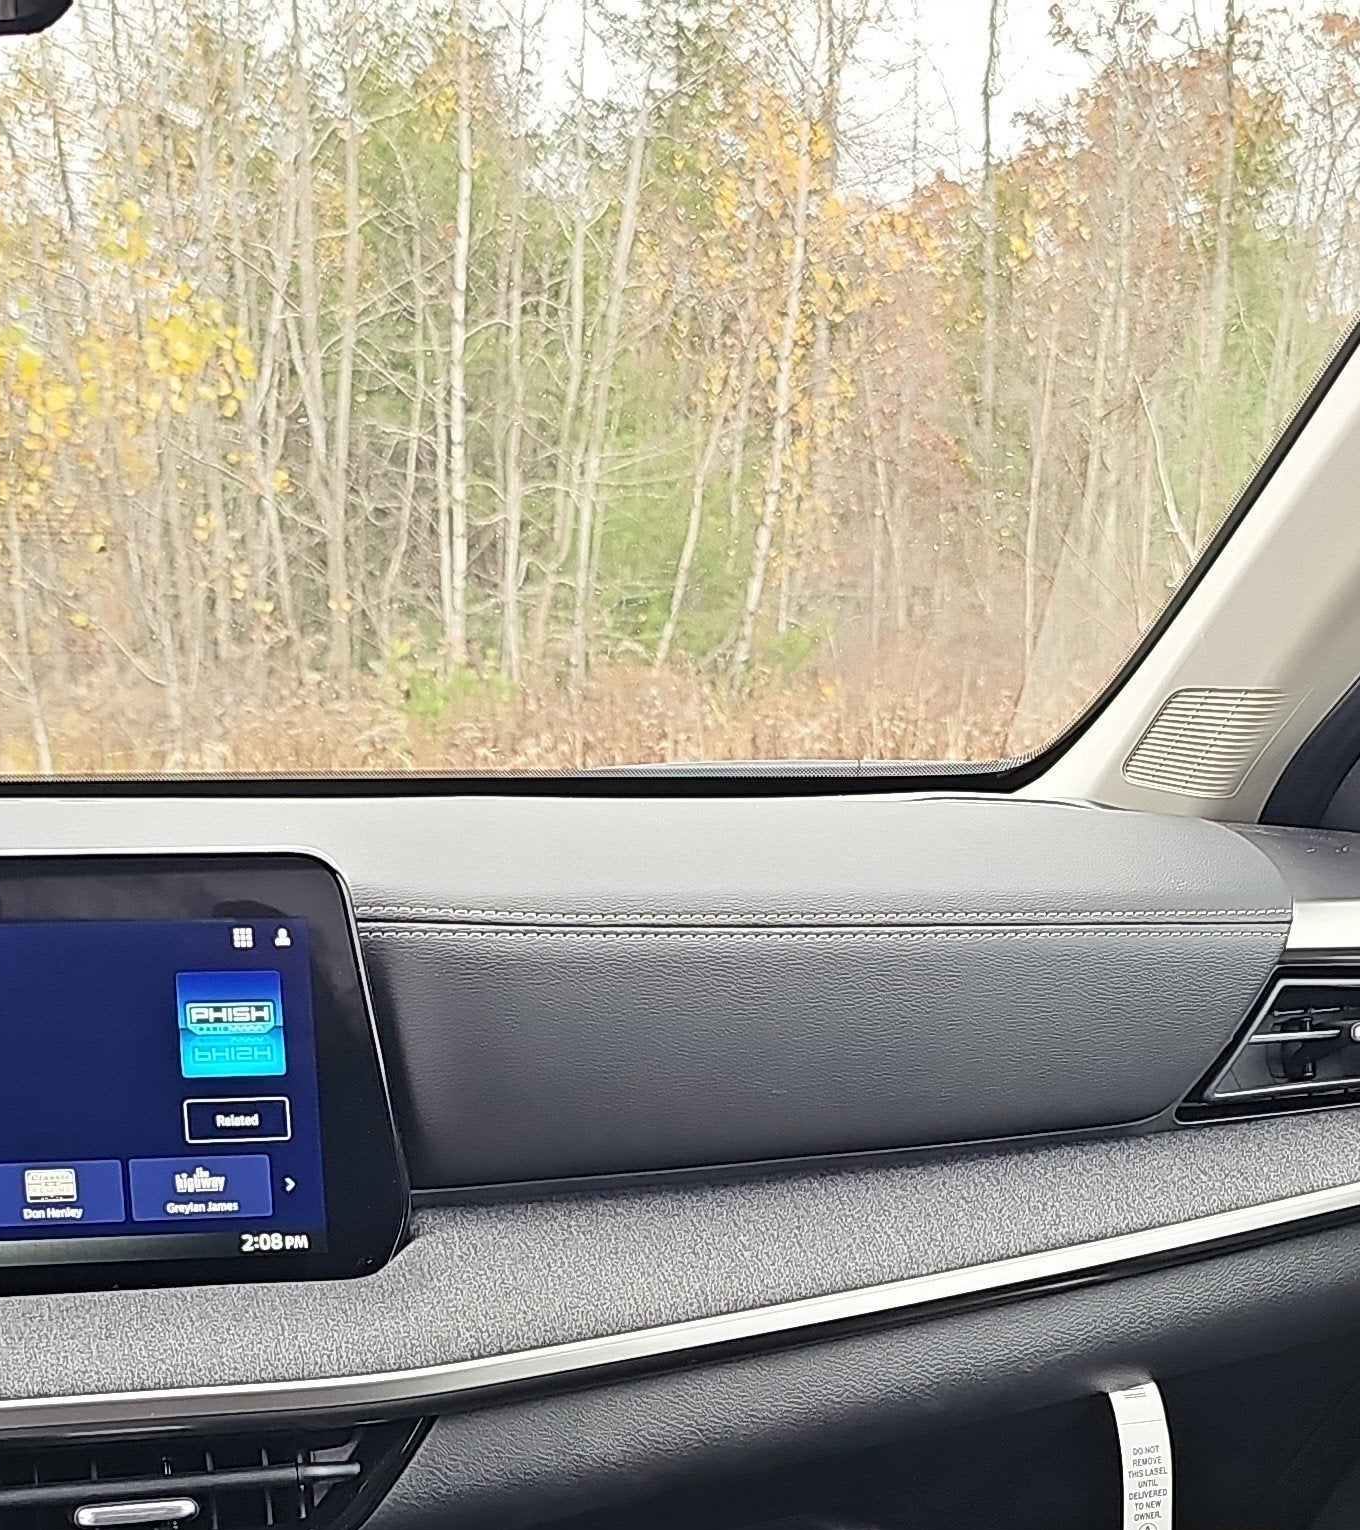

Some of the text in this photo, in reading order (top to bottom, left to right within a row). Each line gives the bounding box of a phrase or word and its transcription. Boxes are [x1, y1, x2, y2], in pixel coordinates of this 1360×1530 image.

[190, 1006, 270, 1023] PHISH
[215, 1113, 259, 1127] Related
[207, 1201, 239, 1212] James
[23, 1208, 46, 1220] Don
[241, 1232, 309, 1252] 2:08 PM
[1132, 1456, 1162, 1467] REMOVE
[1128, 1467, 1168, 1479] THIS LABEL
[1137, 1479, 1158, 1488] UNTIL
[1128, 1489, 1168, 1501] DELIVERED
[1134, 1500, 1162, 1511] TO NEW
